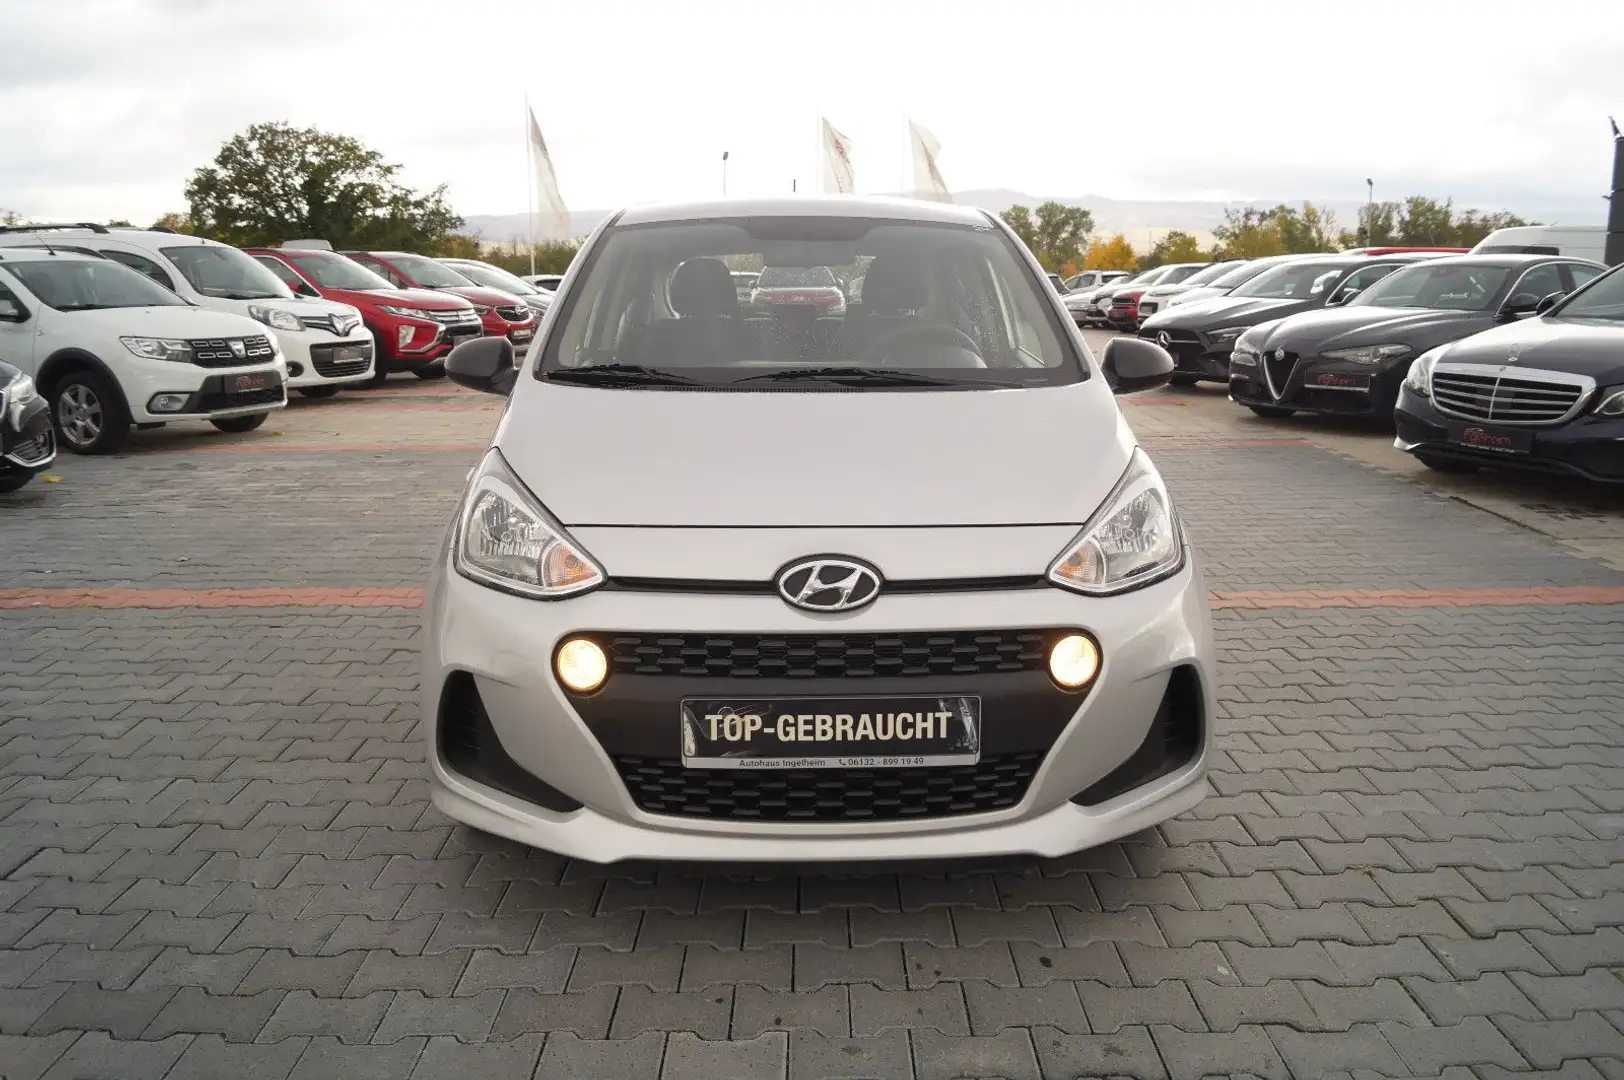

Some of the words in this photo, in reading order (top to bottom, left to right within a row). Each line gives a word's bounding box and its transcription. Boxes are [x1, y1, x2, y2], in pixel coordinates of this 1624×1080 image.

[704, 712, 952, 742] TOP-GEBRAUCHT
[739, 759, 780, 767] Autohaus
[782, 758, 826, 768] Ingelheim
[848, 758, 875, 766] 06132
[883, 757, 899, 766] 899
